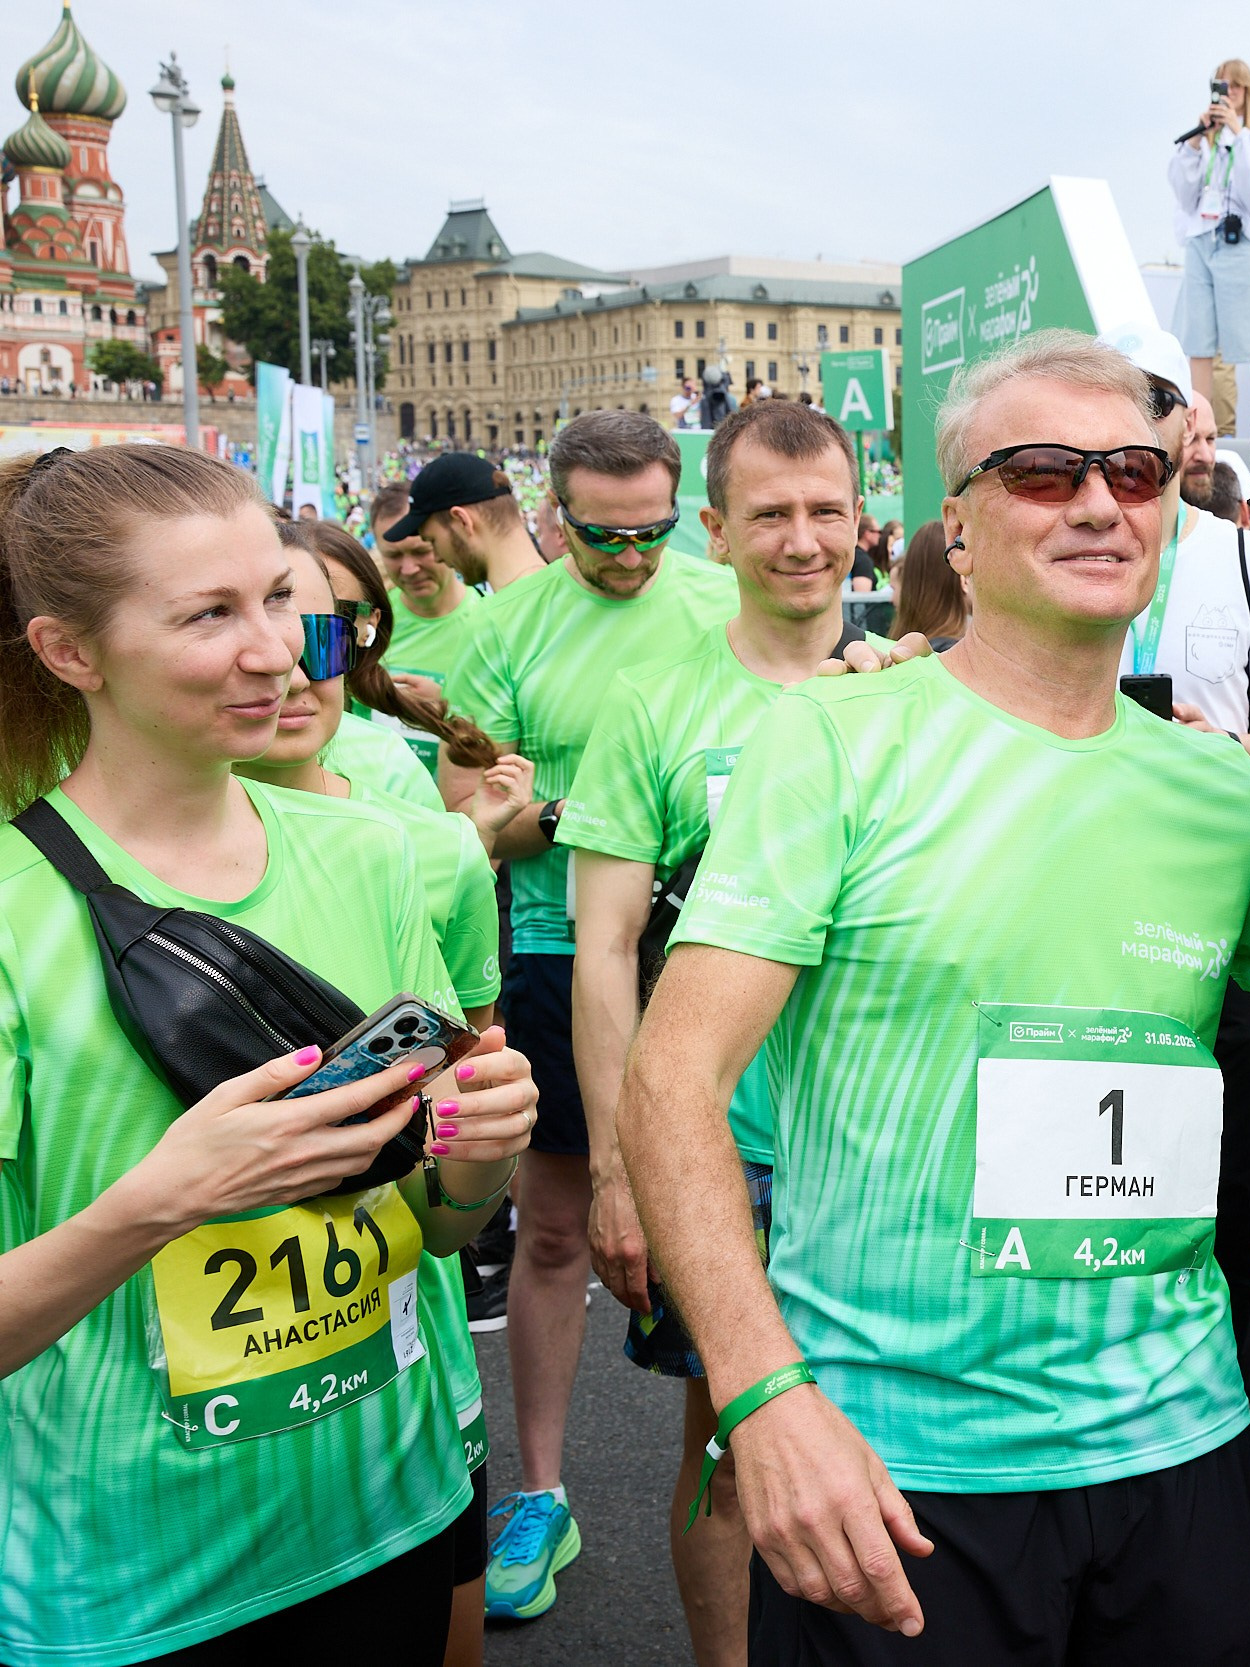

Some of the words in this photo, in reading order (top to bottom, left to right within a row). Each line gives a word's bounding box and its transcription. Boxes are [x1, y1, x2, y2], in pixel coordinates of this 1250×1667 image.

[839, 377, 874, 421] A
[1133, 920, 1205, 952] зелёный
[1121, 940, 1204, 971] марафон
[1026, 1027, 1056, 1038] Прайм
[1081, 1033, 1115, 1043] марафон
[1085, 1025, 1118, 1035] зелёный
[1144, 1031, 1197, 1049] 31.05.2025
[1098, 1089, 1124, 1166] 1
[1065, 1175, 1155, 1198] ГЕРМАН
[994, 1226, 1032, 1271] A
[203, 1205, 390, 1332] 2161
[243, 1286, 382, 1358] АНАСТАСИЯ
[204, 1394, 241, 1437] C
